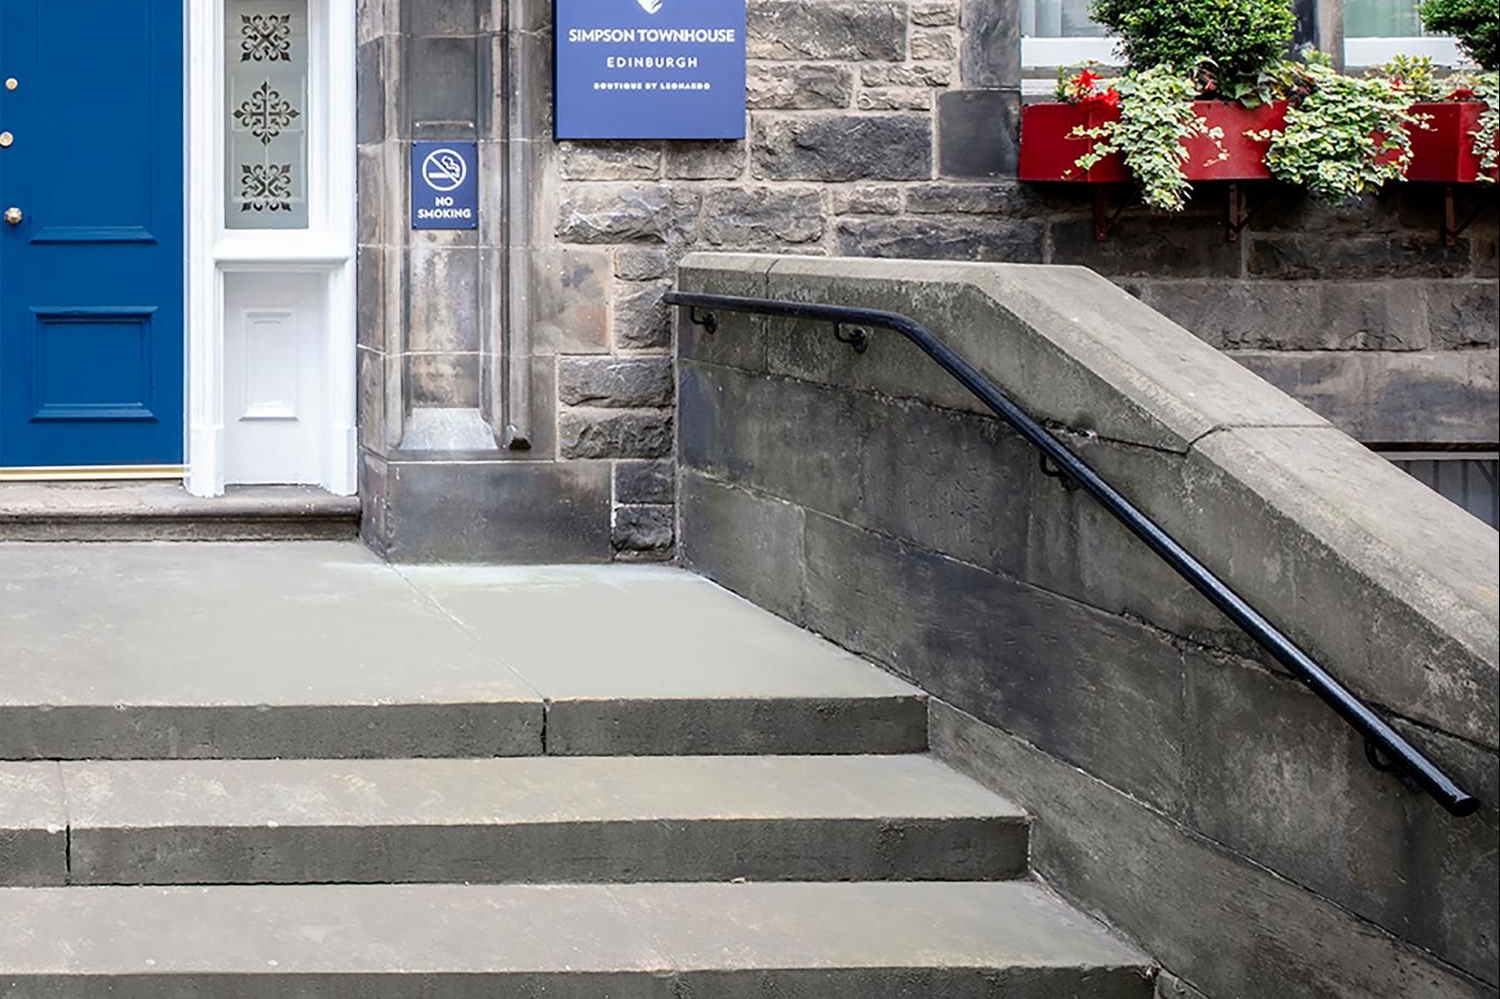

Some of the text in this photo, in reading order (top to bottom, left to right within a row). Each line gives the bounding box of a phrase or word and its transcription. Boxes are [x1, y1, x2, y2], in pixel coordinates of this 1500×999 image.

[568, 28, 736, 43] SIMPSON TOWNHOUSE
[606, 56, 698, 68] EDINBURGH
[593, 82, 711, 91] BOUTIQUE BY LEONARDO
[435, 196, 454, 207] NO
[417, 208, 472, 219] SMOKING
